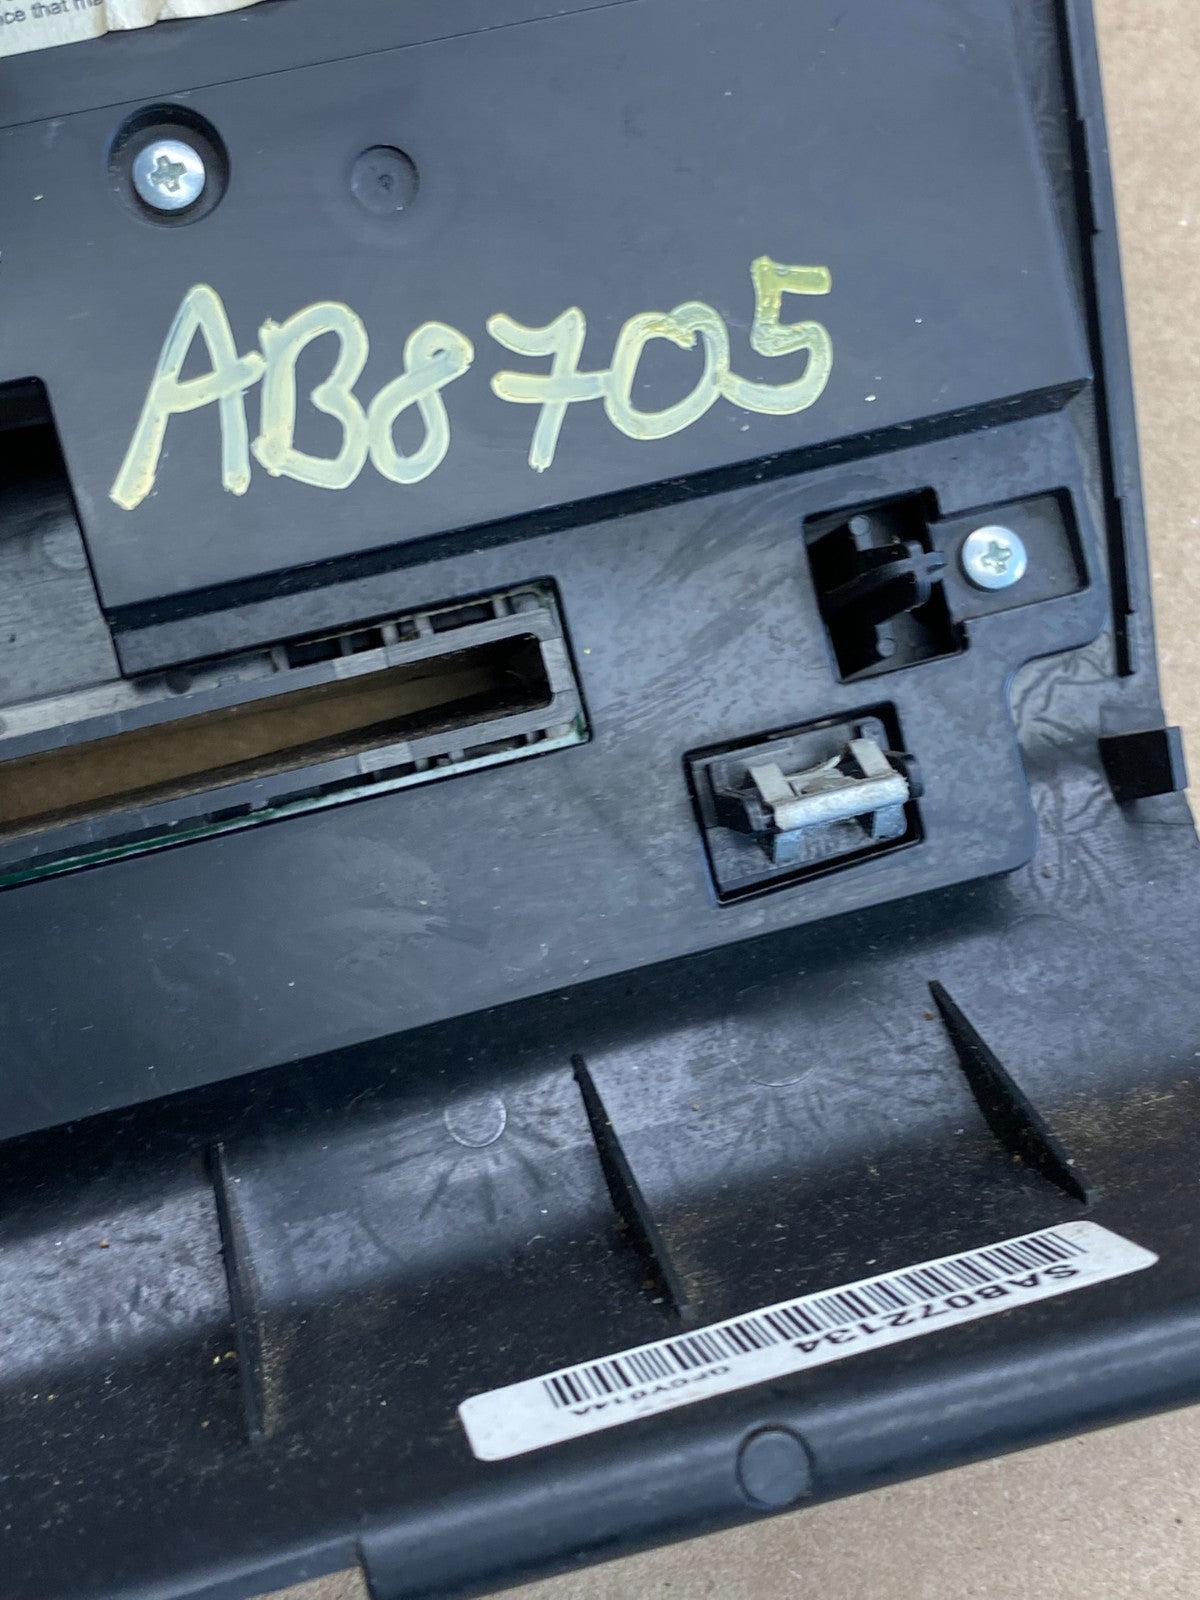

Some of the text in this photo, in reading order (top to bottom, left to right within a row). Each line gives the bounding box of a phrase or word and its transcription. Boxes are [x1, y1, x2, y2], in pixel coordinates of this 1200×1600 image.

[30, 1, 70, 19] that
[110, 256, 833, 510] AB8705
[794, 1263, 1080, 1354] SAB072134
